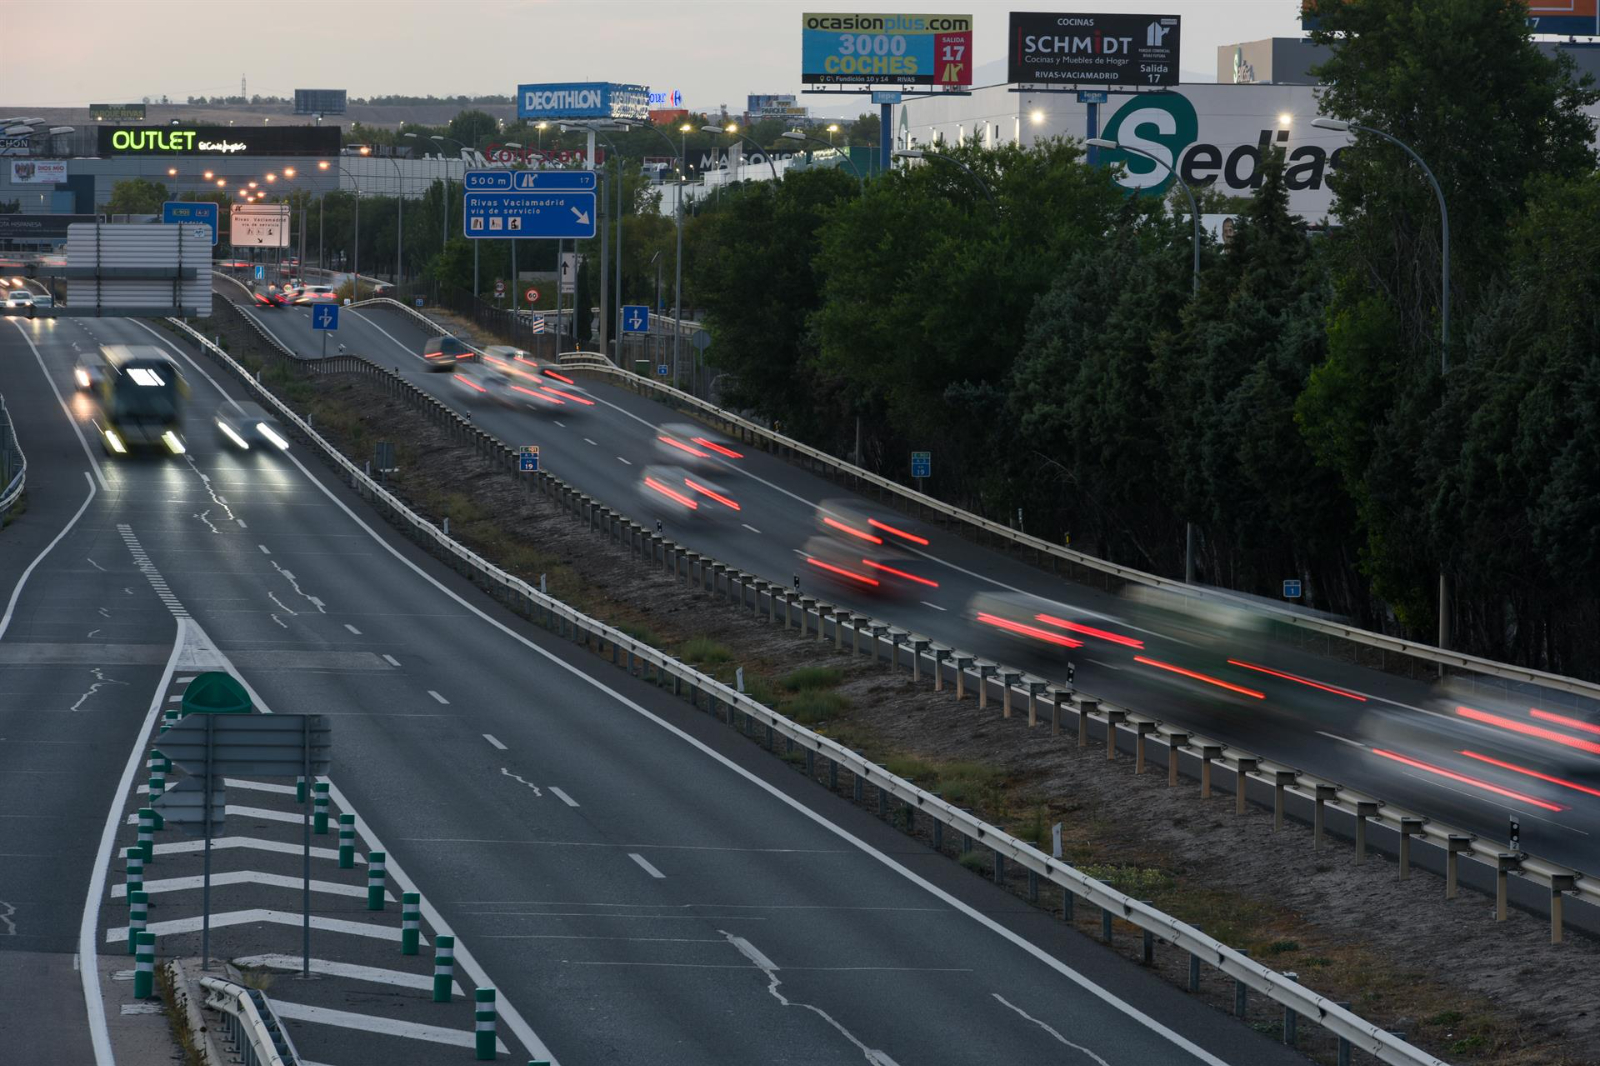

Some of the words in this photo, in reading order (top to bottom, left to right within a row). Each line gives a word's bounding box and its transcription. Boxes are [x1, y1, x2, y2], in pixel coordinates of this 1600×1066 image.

[807, 15, 969, 33] ocasionplus.com
[1057, 18, 1094, 26] COCINAS
[838, 34, 907, 56] 3000
[942, 46, 965, 61] 17
[824, 55, 918, 75] COCHES
[1025, 55, 1054, 64] Cocinas
[1062, 56, 1093, 64] Muebles
[1095, 57, 1104, 65] de
[1106, 58, 1129, 66] Hogar
[1140, 64, 1168, 73] Salida
[1035, 71, 1119, 80] RIVAS-VACIAMADRID
[1147, 74, 1161, 83] 17
[525, 89, 601, 111] DECATHLON
[112, 130, 196, 150] OUTLET
[470, 176, 494, 185] 500
[470, 199, 498, 207] Rivas
[503, 198, 565, 207] Vaciamadrid
[488, 207, 499, 215] de
[503, 207, 541, 215] servicio
